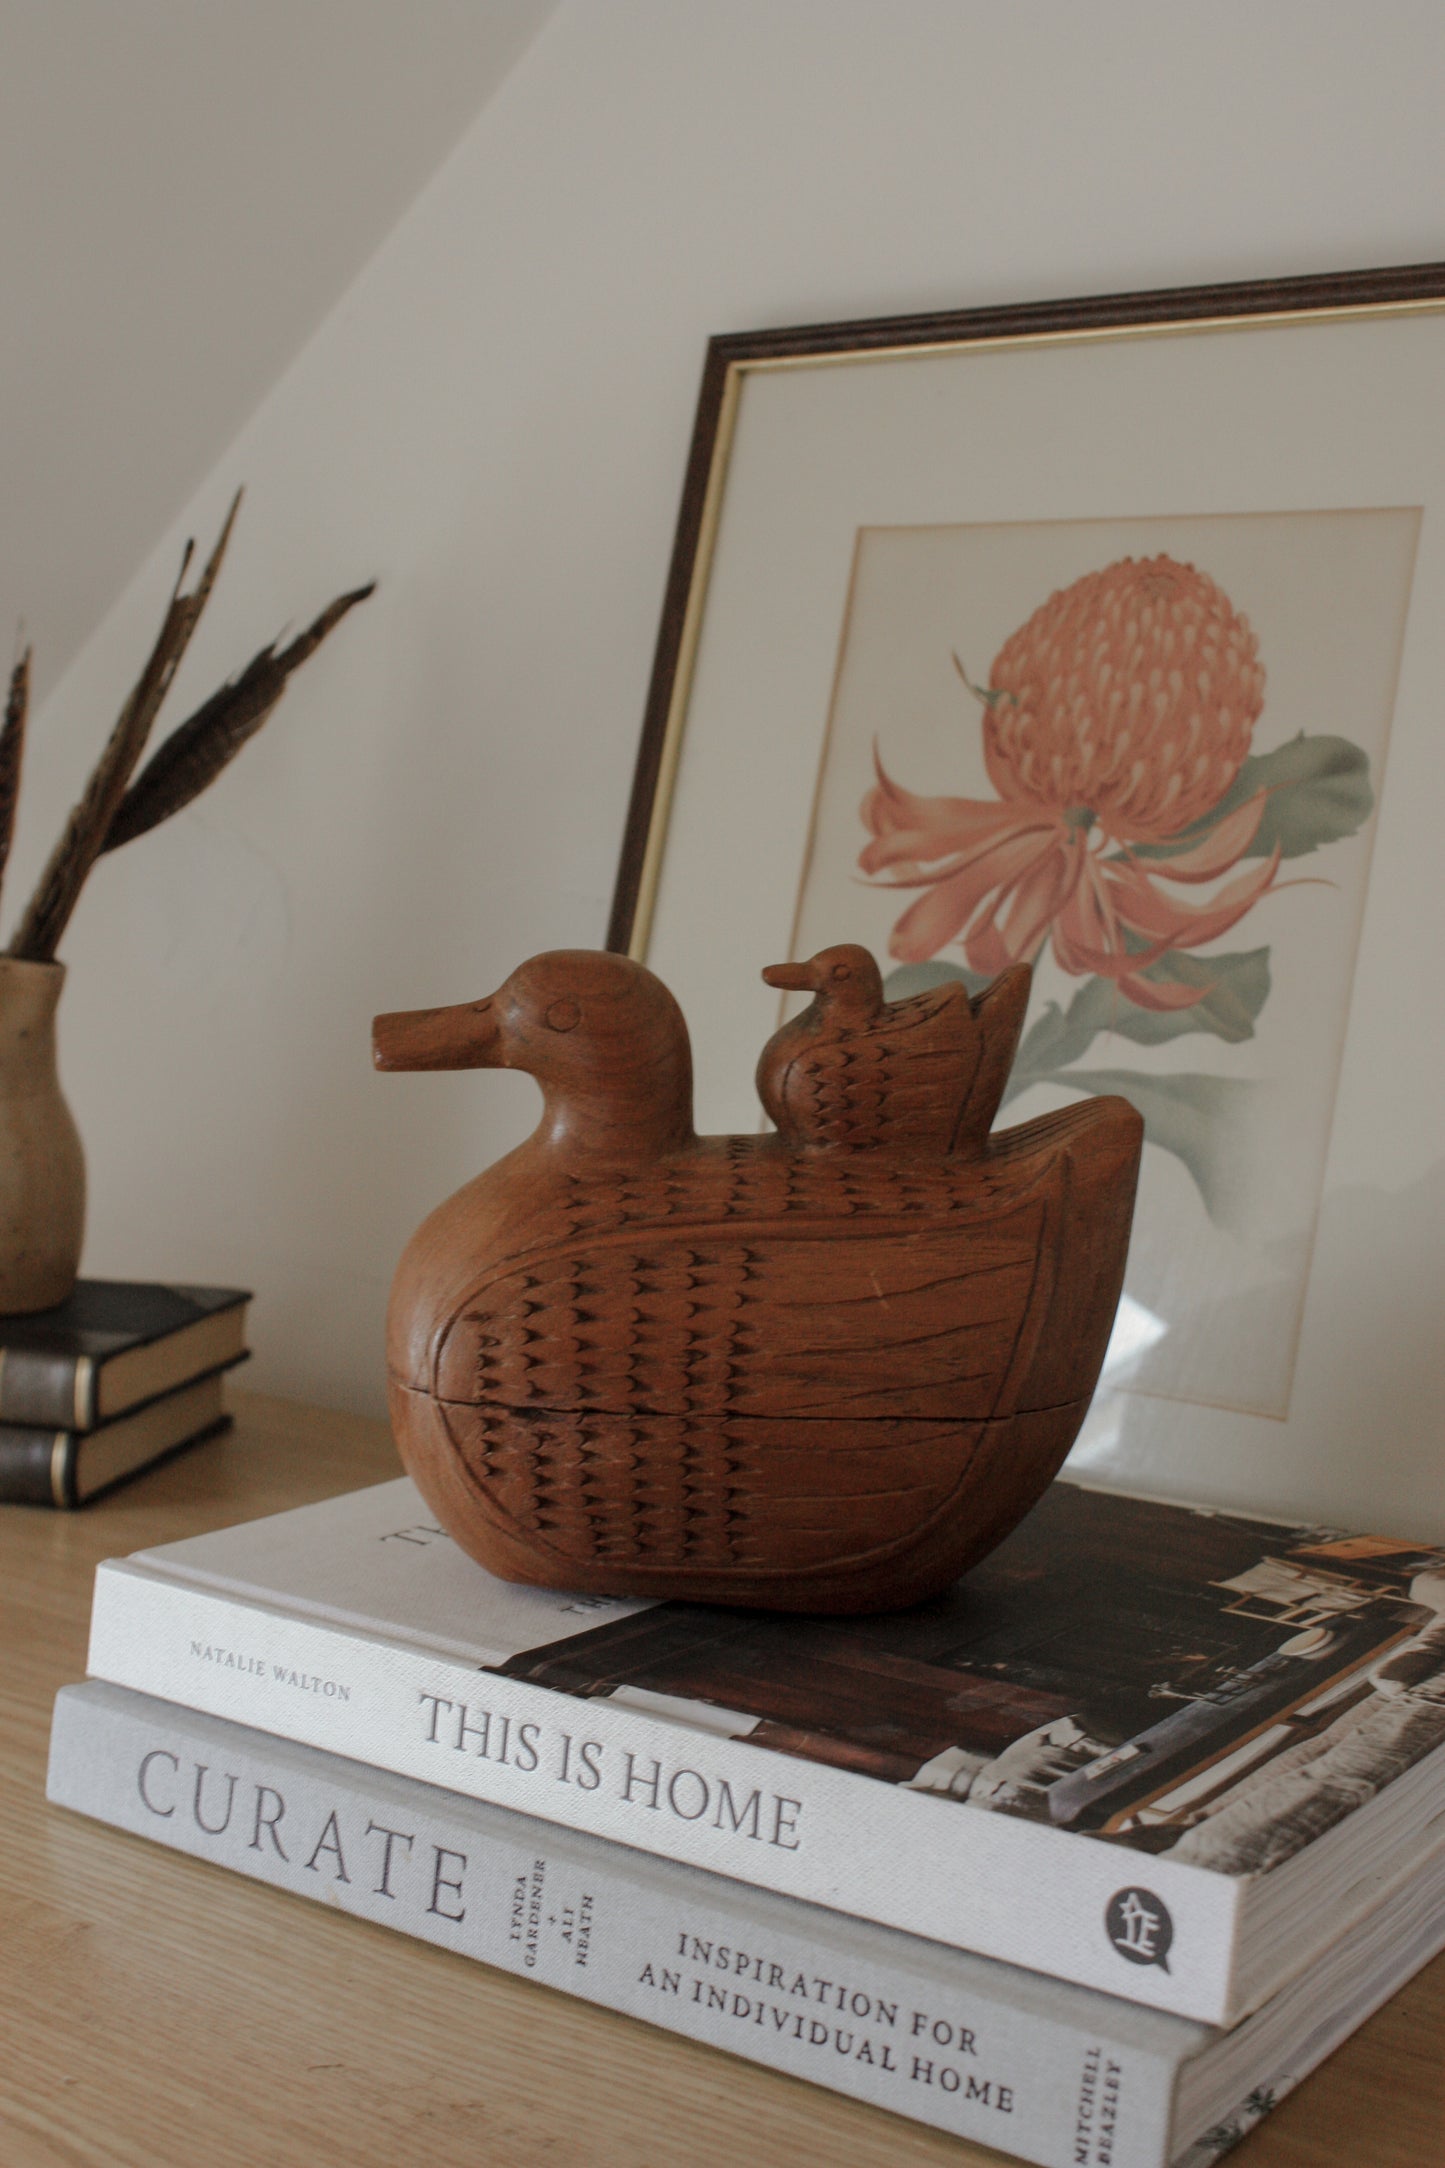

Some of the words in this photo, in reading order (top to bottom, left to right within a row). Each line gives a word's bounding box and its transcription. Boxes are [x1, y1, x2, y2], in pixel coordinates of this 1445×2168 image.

[189, 1640, 266, 1677] NATALIE
[273, 1664, 352, 1701] WALTON
[418, 1693, 541, 1773] THIS
[556, 1733, 604, 1791] IS
[619, 1751, 803, 1852] HOME
[137, 1750, 468, 1924] CURATE
[510, 1876, 526, 1941] LYNDA
[524, 1860, 546, 1968] GARDENER
[562, 1906, 574, 1944] ALI
[576, 1893, 594, 1967] HEATH
[637, 1963, 682, 1996] AN
[692, 1979, 898, 2073] INDIVIDUAL
[910, 2055, 1014, 2114] HOME
[677, 1932, 898, 2028] INSPIRATION
[910, 2010, 978, 2057] FOR
[1074, 2048, 1101, 2166] MITCHELL
[1097, 2060, 1121, 2166] BEAZLEY
